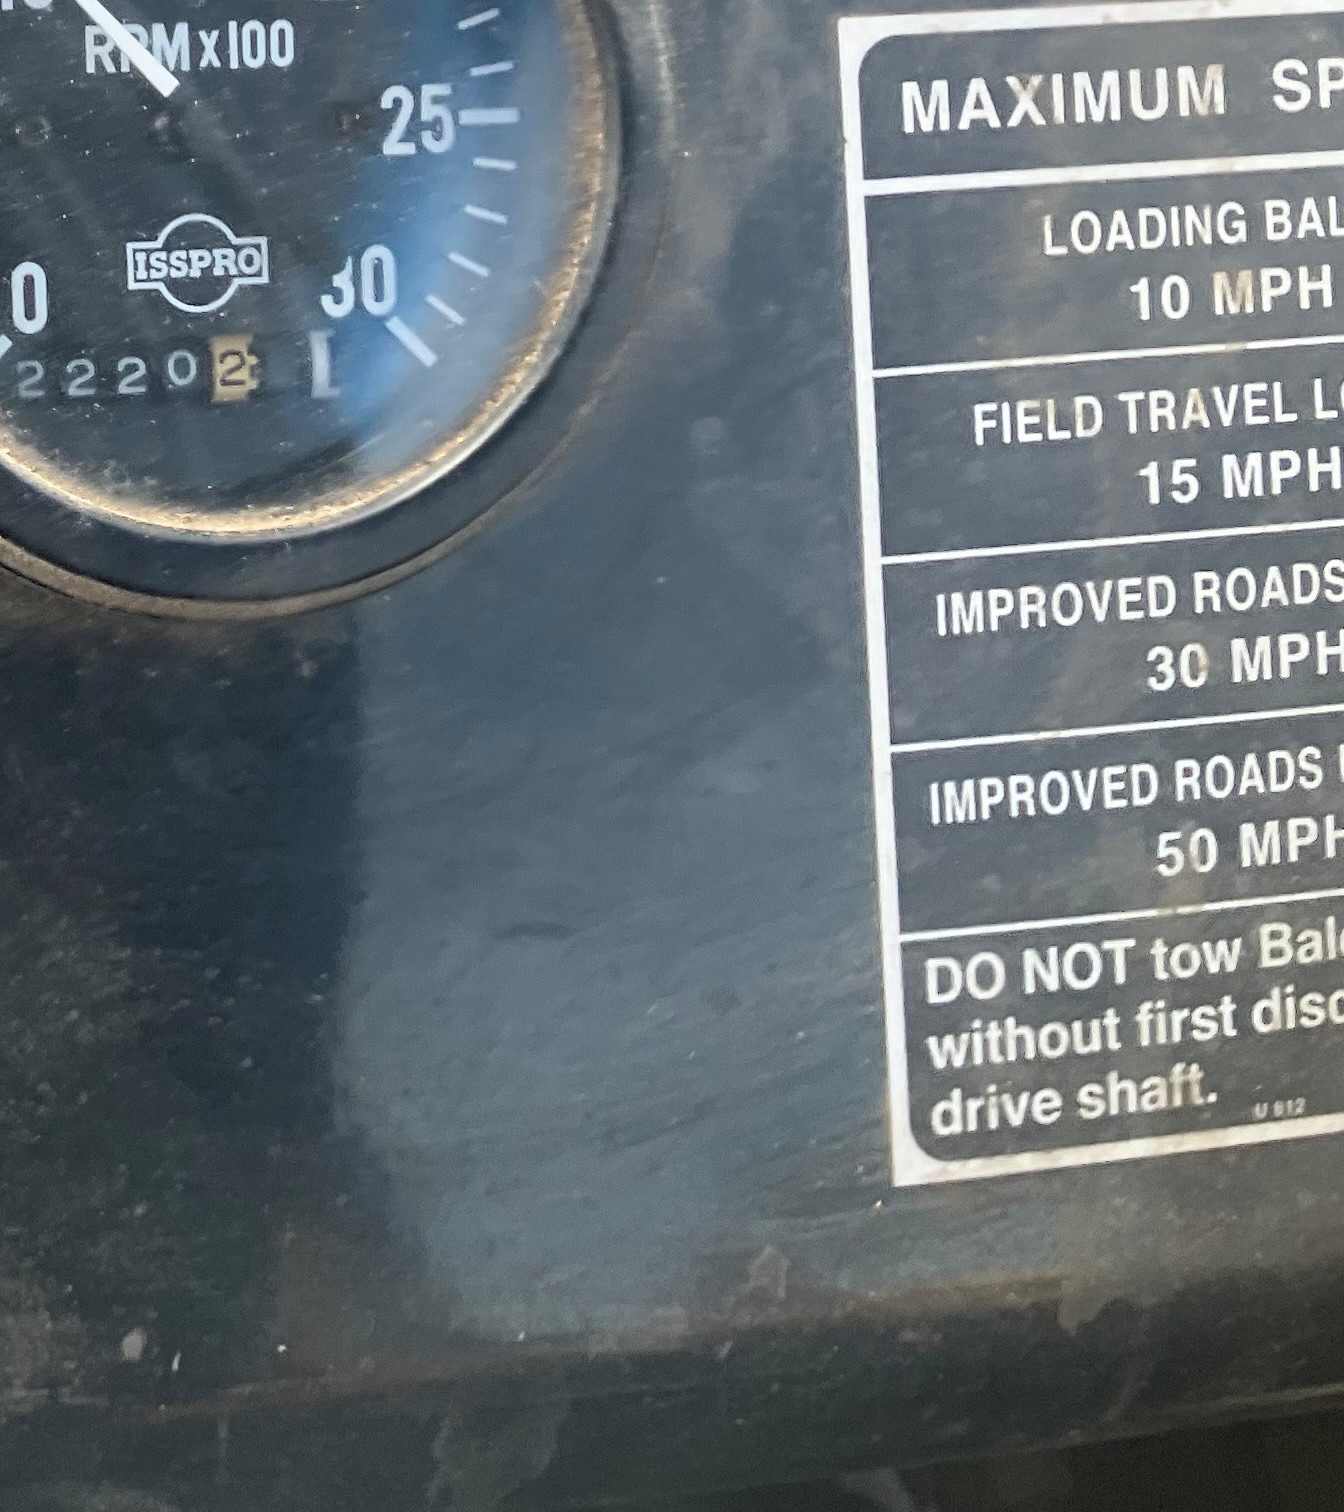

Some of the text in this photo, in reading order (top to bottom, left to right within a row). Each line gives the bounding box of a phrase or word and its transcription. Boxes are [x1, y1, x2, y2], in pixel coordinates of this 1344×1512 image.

[381, 85, 458, 157] 25
[900, 63, 1226, 134] MAXIMUM
[1042, 195, 1344, 256] LOADING BAL
[10, 261, 49, 335] 0
[133, 247, 263, 281] ISSPRO
[1129, 263, 1333, 321] 10 MPH
[973, 377, 1344, 446] FIELD TRAVEL L
[1138, 445, 1342, 505] 15 MPH
[935, 558, 1344, 637] IMPROVED ROADS
[1146, 628, 1344, 692] 30 MPH
[929, 765, 1160, 825] IMPROVED
[1174, 746, 1323, 802] ROADS
[1155, 827, 1219, 878] 50
[924, 915, 1344, 1006] DO NOT tow Bal
[925, 1010, 1122, 1072] without
[1135, 993, 1238, 1049] first
[930, 1061, 1220, 1137] drive shaft.
